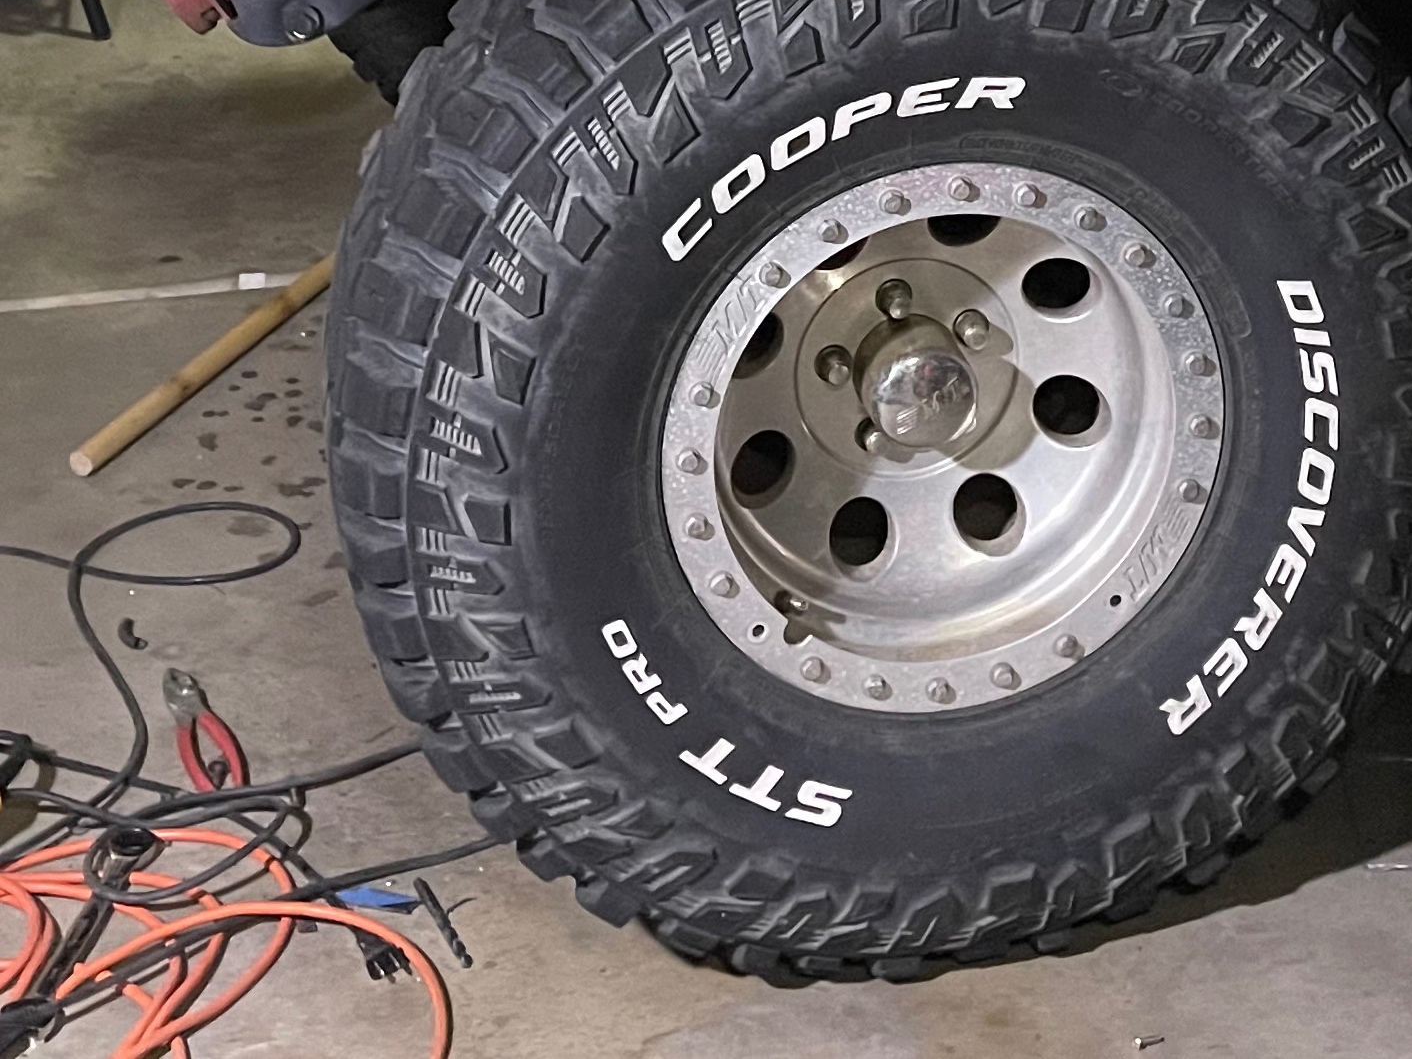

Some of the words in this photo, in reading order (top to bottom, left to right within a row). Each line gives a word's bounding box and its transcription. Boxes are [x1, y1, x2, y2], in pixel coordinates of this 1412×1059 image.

[662, 77, 1026, 262] COOPER
[1159, 280, 1339, 735] DISCOVERER
[601, 619, 688, 725] PRO
[679, 738, 853, 827] STT
